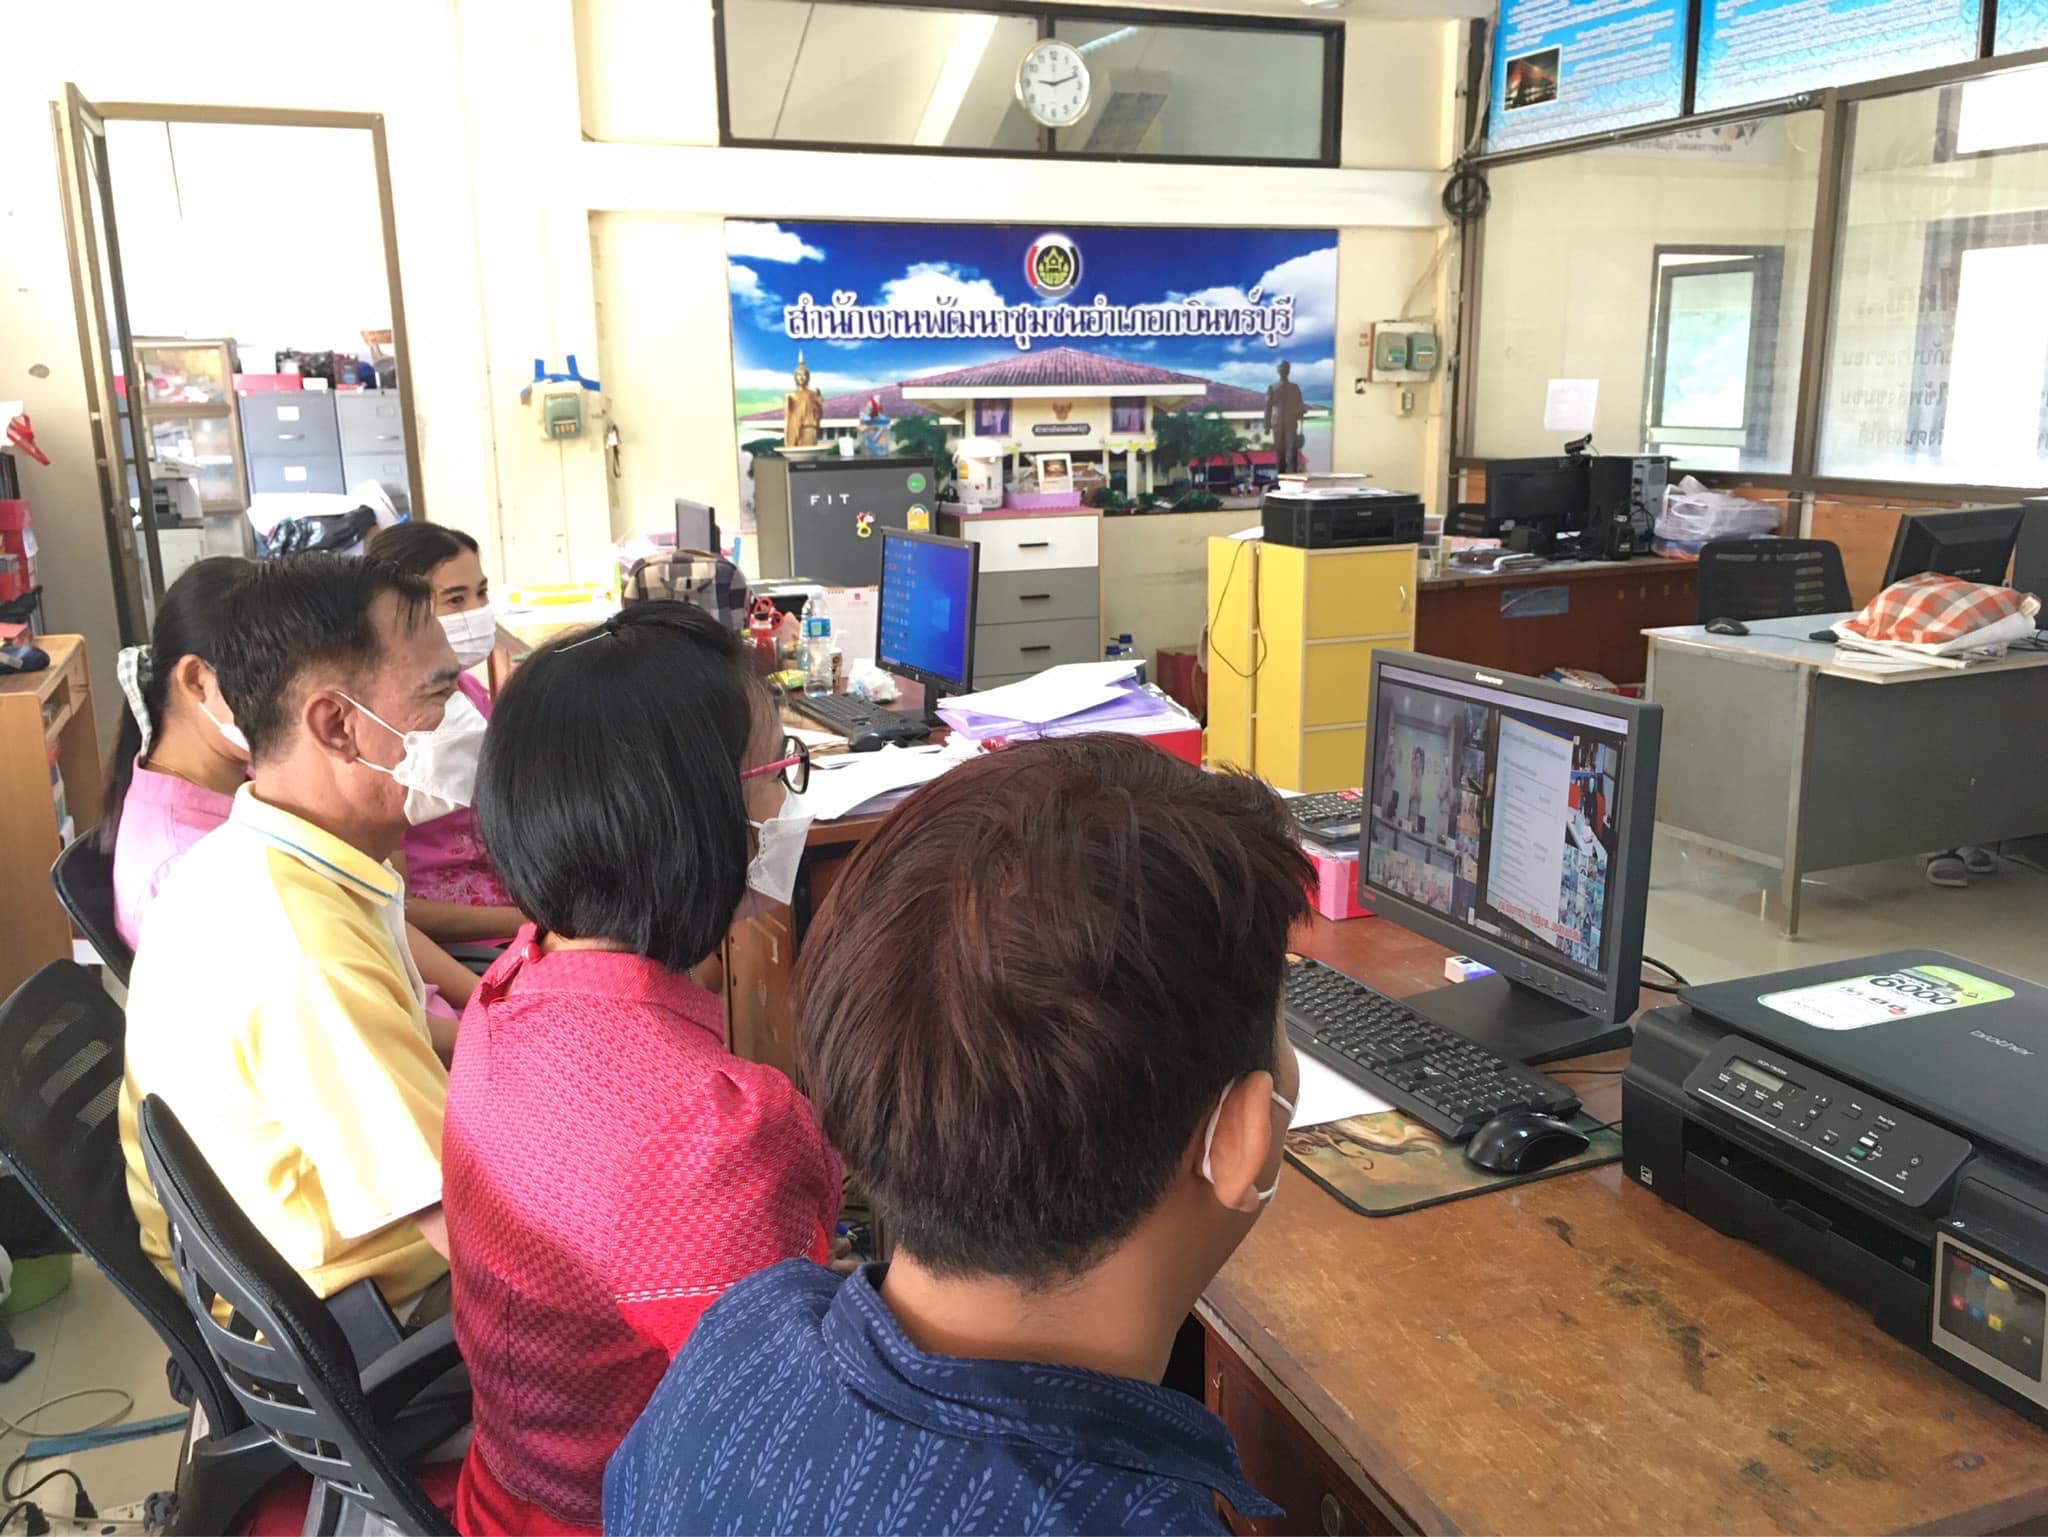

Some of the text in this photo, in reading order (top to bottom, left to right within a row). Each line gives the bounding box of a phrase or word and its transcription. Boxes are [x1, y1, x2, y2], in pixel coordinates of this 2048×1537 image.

[787, 287, 1292, 347] สำนักงานพัฒนาชุมชนอำเภอกบินทร์บุรี
[1869, 977, 1958, 1005] 6000
[1969, 1029, 2036, 1056] brother
